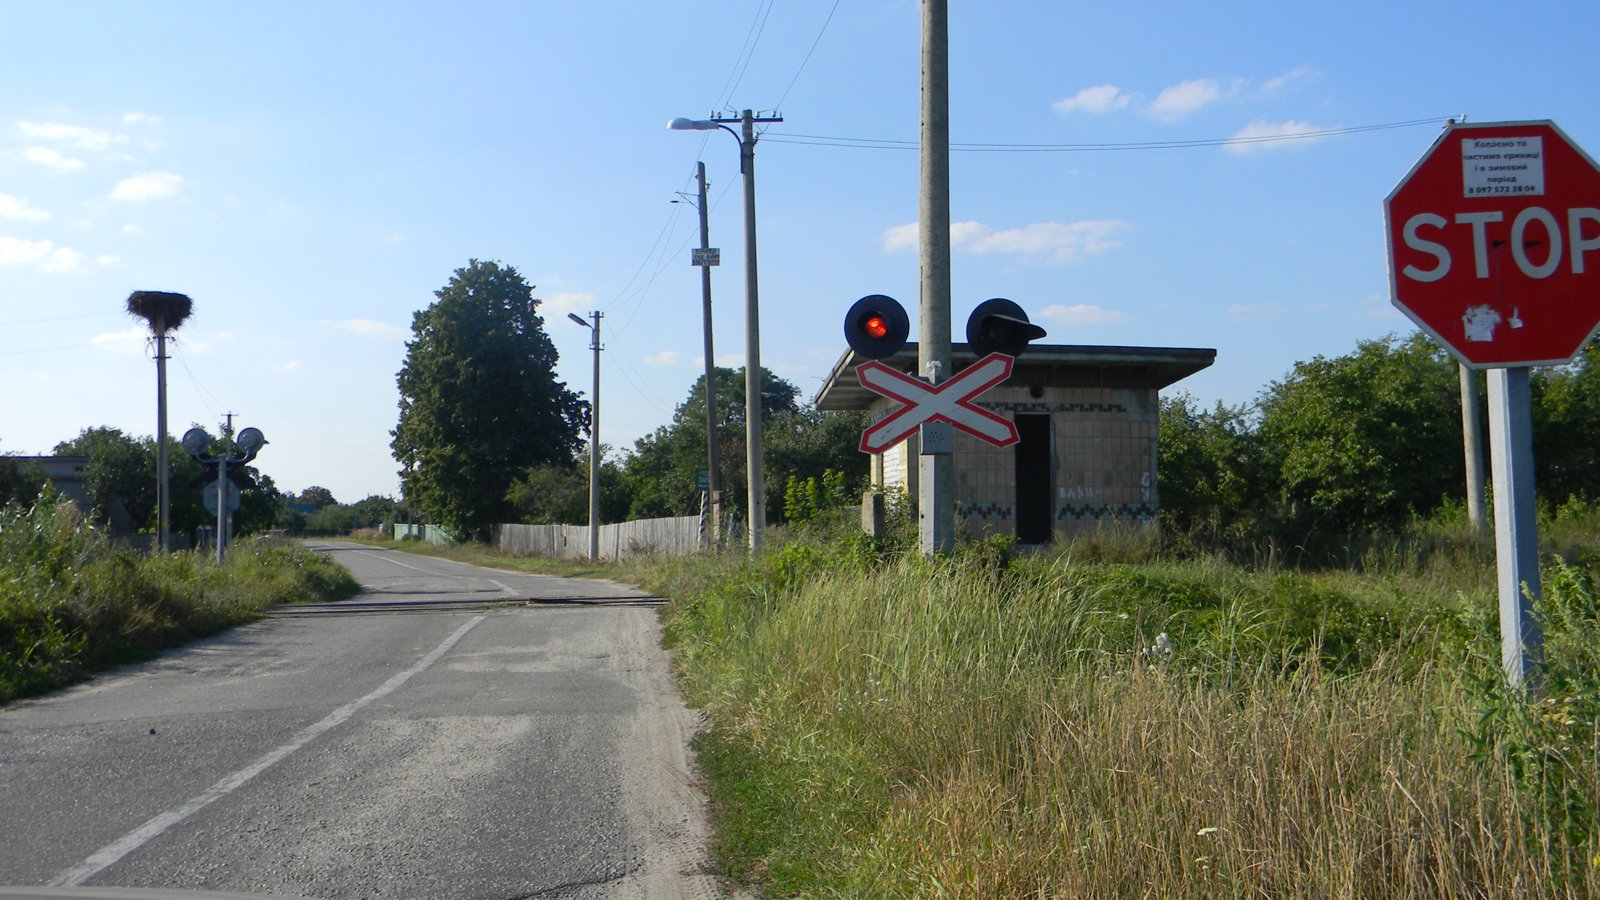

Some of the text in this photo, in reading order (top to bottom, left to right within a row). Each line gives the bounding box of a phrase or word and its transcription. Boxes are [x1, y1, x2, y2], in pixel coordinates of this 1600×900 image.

[1488, 163, 1528, 172] зимовий
[1487, 176, 1517, 184] період
[1476, 186, 1492, 194] 097
[1402, 206, 1600, 283] STOP
